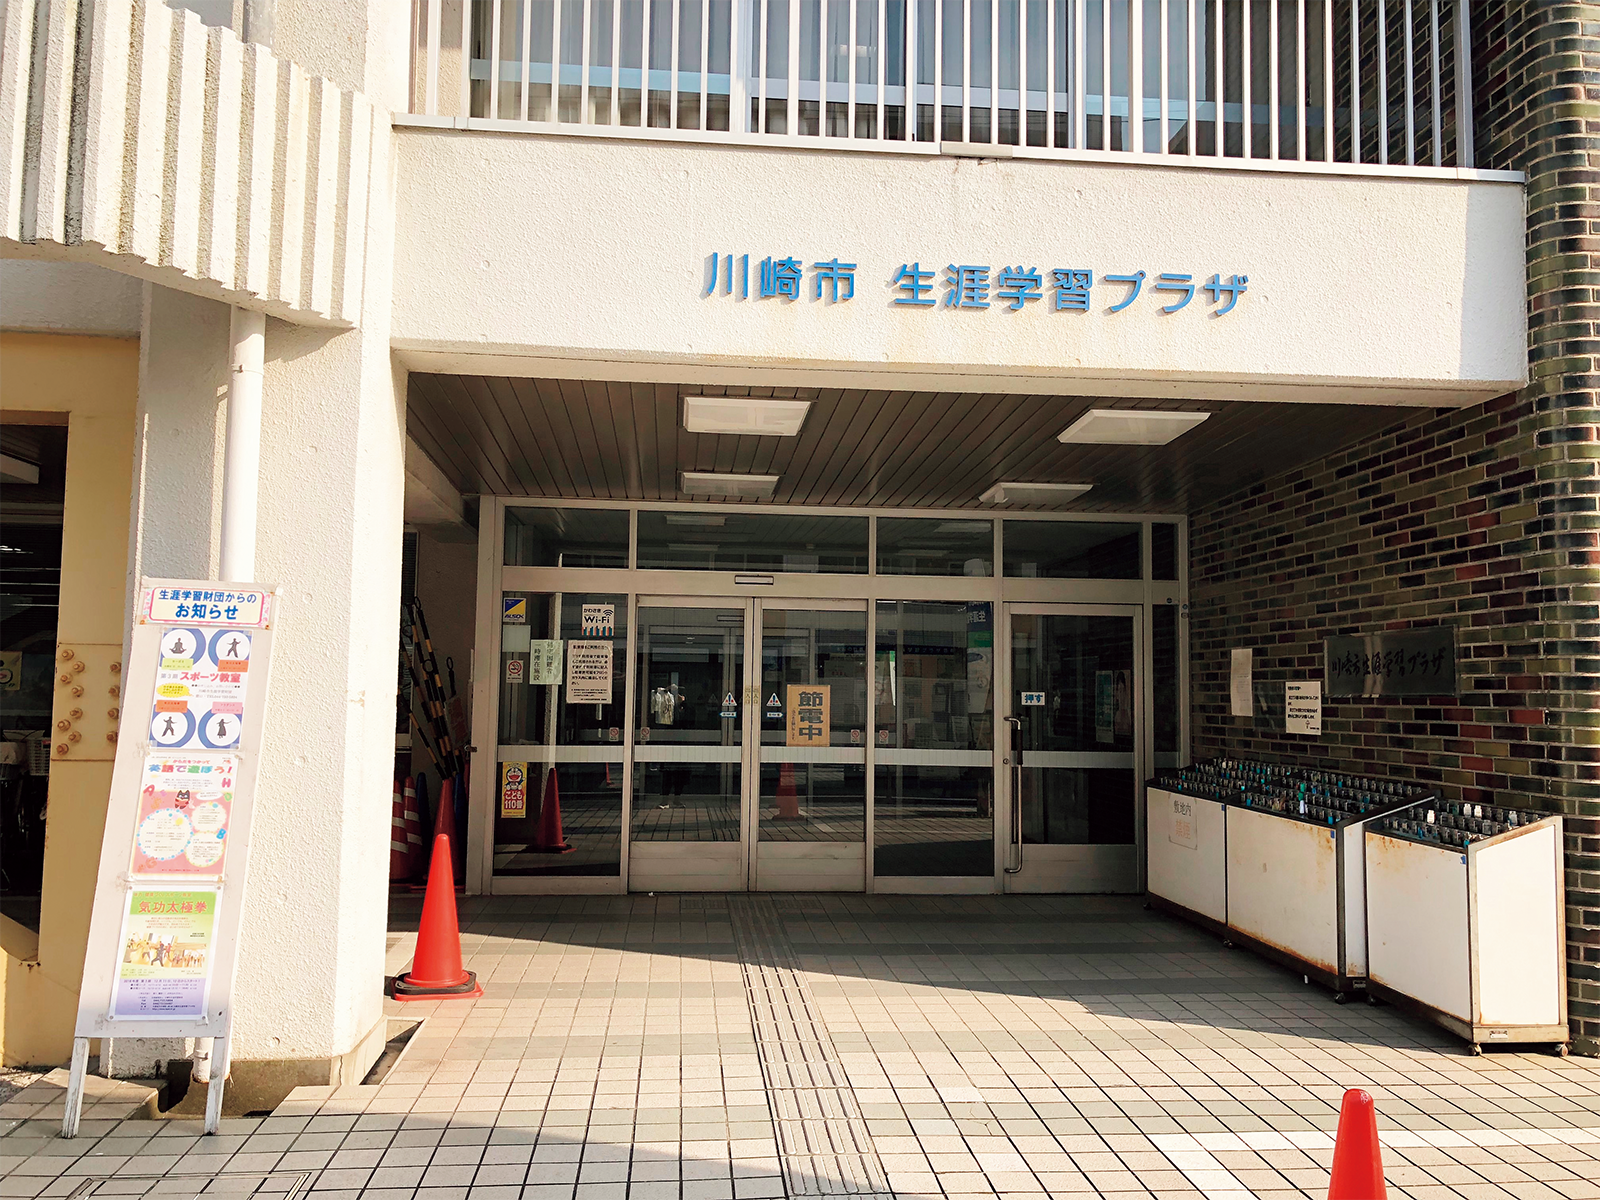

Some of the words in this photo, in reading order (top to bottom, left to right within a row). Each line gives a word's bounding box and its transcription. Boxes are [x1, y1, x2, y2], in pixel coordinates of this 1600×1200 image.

[704, 252, 857, 303] 川崎市
[895, 262, 1248, 317] 生涯学習プラザ
[158, 589, 257, 603] 生涯学習財団からの
[175, 602, 239, 620] お知らせ
[583, 616, 610, 624] Wi-Fi
[180, 672, 241, 683] スポーツ教室
[1024, 693, 1043, 703] 押す
[798, 691, 824, 741] 節電中
[505, 791, 523, 800] こども
[504, 800, 523, 809] 110番
[138, 900, 207, 913] 気功太極拳
